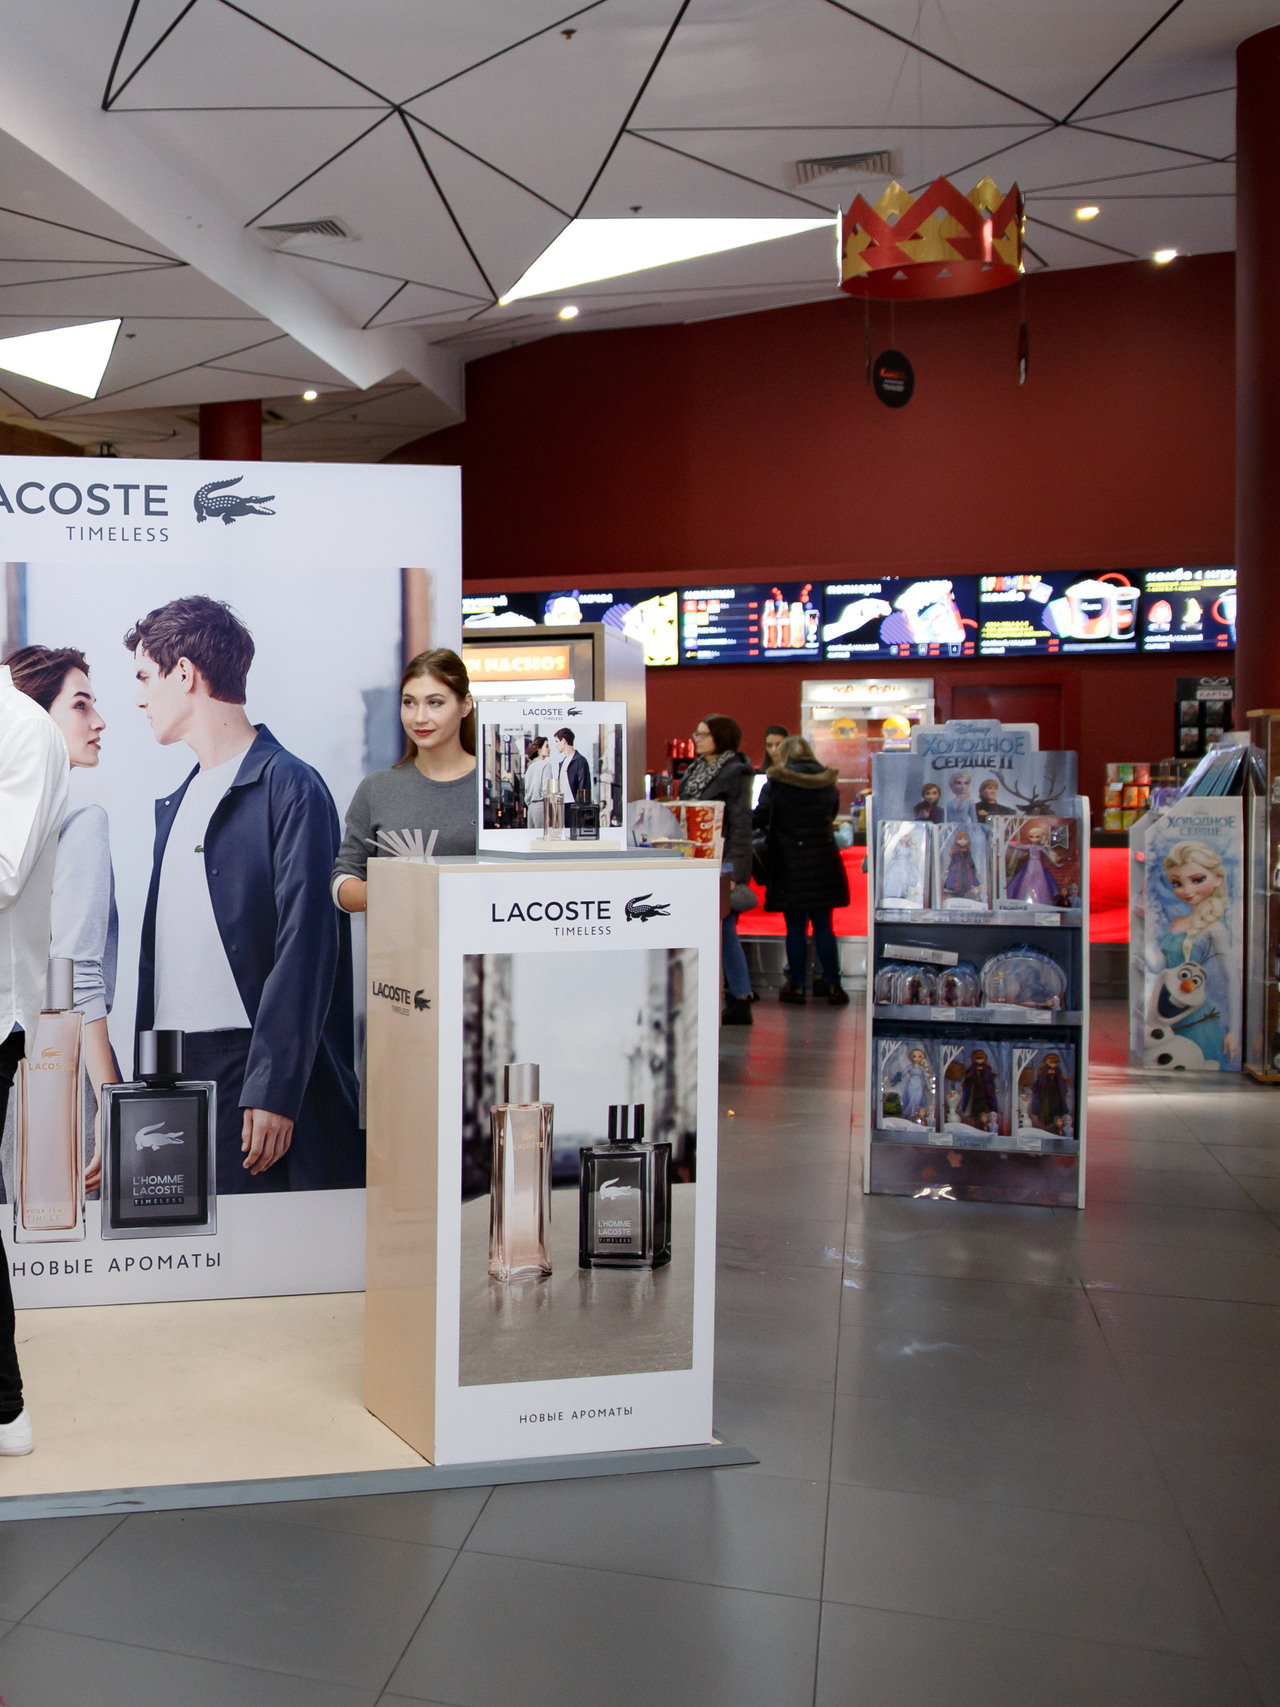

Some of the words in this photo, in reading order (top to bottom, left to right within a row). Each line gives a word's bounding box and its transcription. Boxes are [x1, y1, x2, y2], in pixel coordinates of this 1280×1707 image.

[65, 526, 170, 543] TIMELESS
[484, 655, 566, 673] NACHOS
[522, 708, 563, 716] LACOSTE
[921, 735, 1026, 757] ХОЛОДНОЕ
[931, 754, 997, 771] СЕРДЦЕ
[1167, 815, 1238, 829] ХОЛОДНОЕ
[491, 900, 612, 923] LACOSTE
[553, 925, 612, 937] TIMELESS
[372, 981, 411, 1006] LACOSTE
[28, 1062, 74, 1071] LACOSE
[132, 1174, 184, 1185] L'HOMME
[132, 1185, 184, 1196] LACOSTE
[134, 1197, 184, 1205] TIMELESS
[598, 1219, 631, 1228] L'HOMME
[598, 1228, 631, 1236] LACOSTE
[12, 1258, 93, 1277] НОВЫЕ
[108, 1252, 221, 1273] АРОМАТЫ
[519, 1411, 564, 1424] НОВЫЕ
[571, 1406, 633, 1420] АРОМАТЫ
